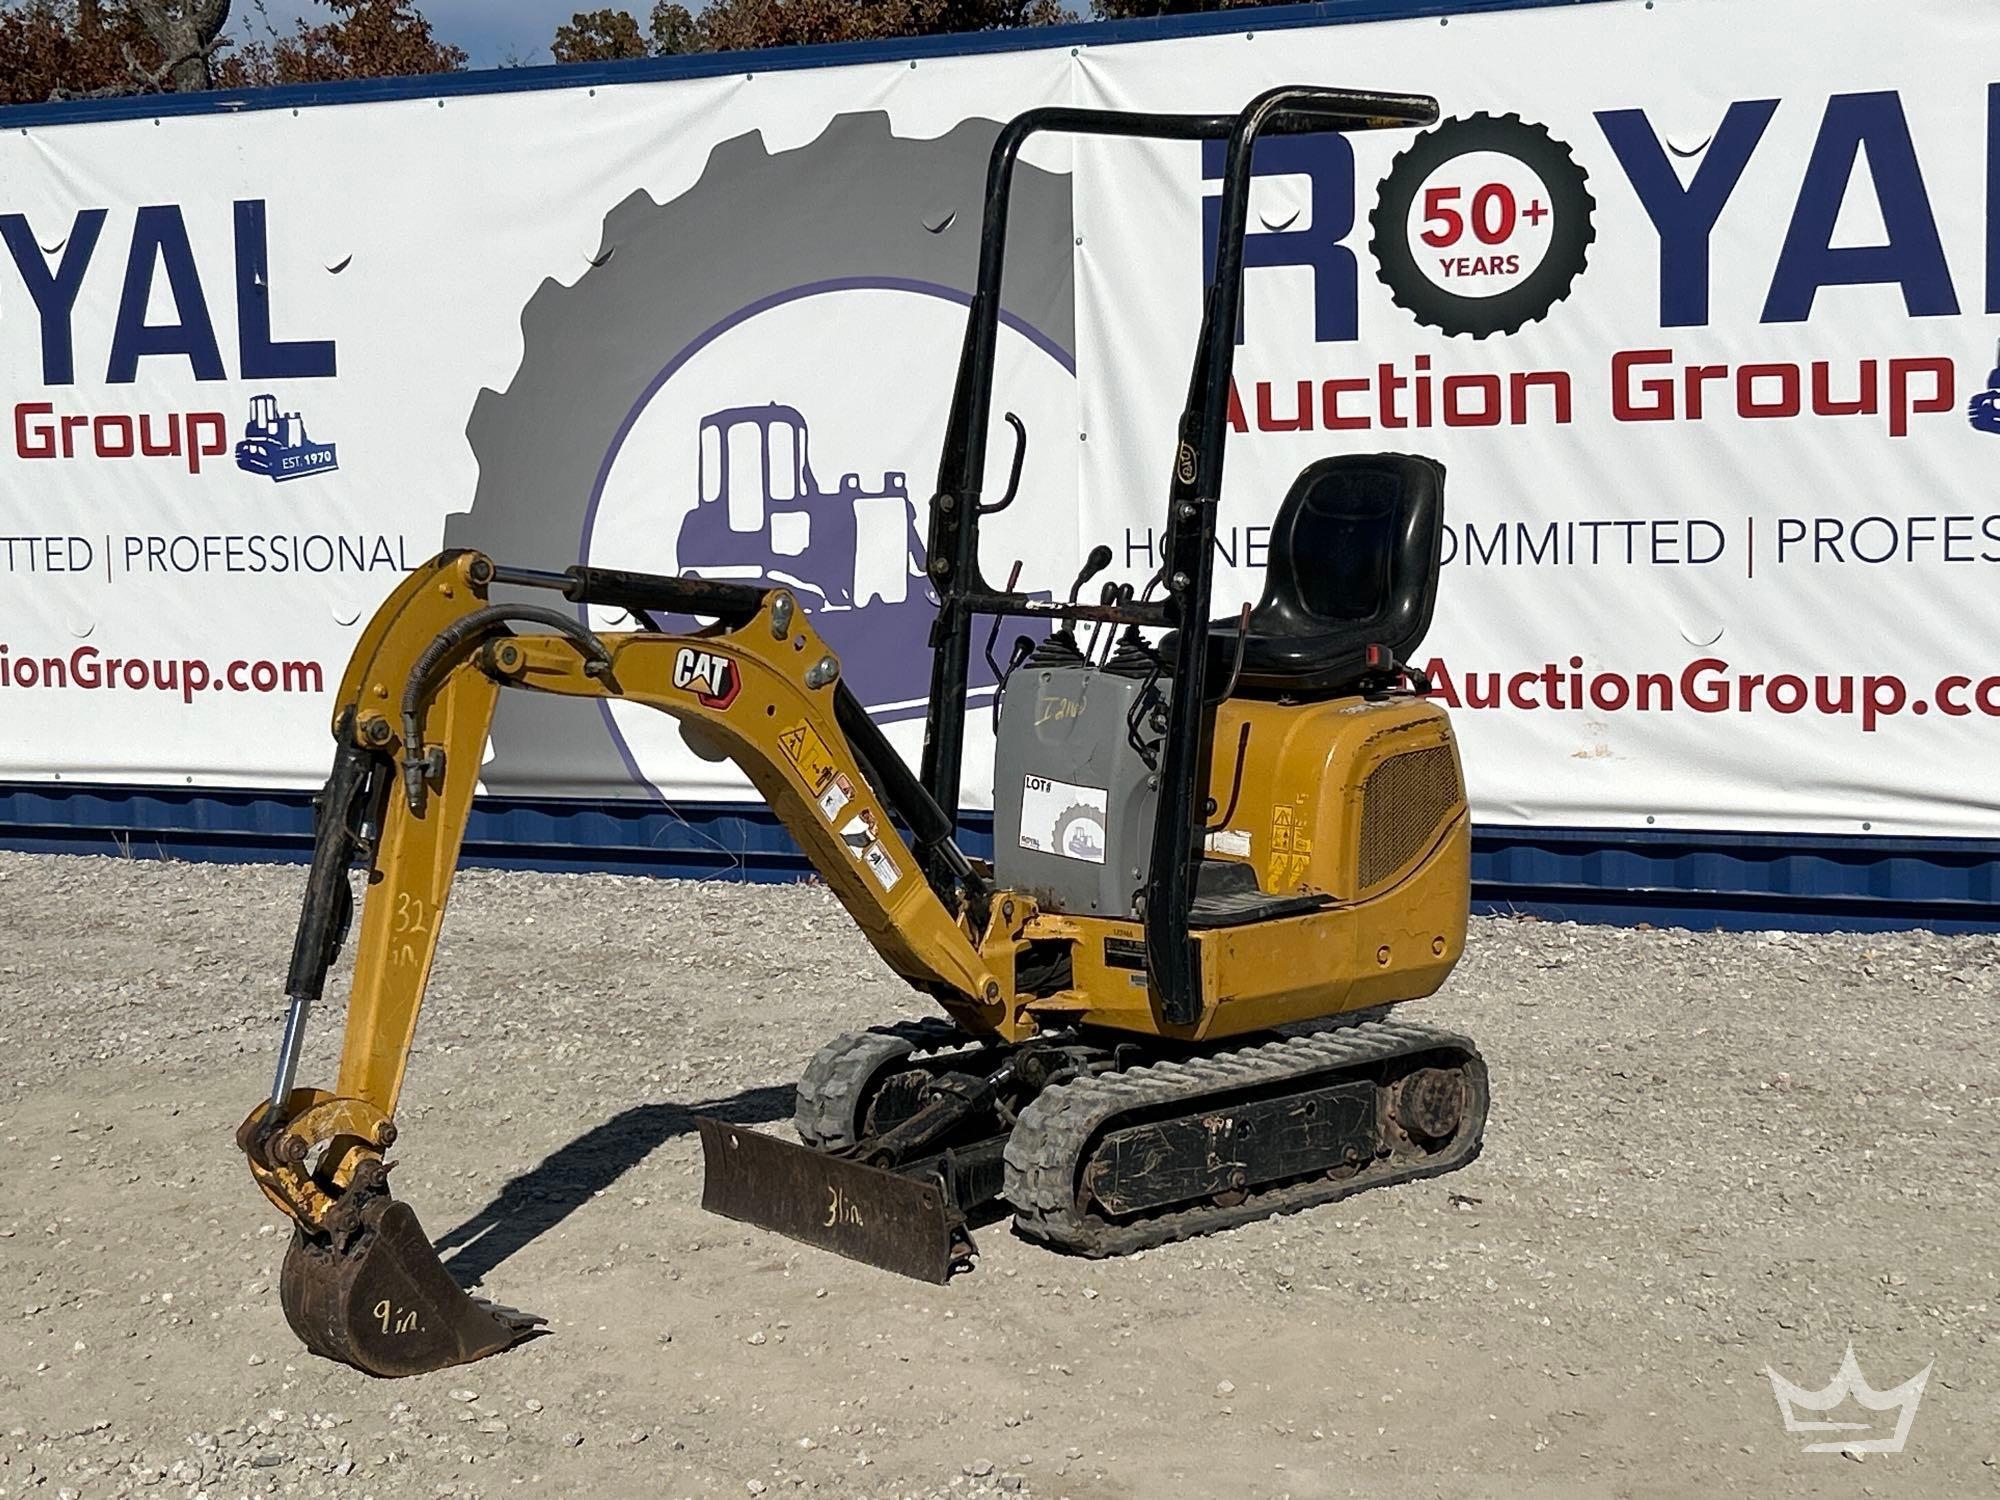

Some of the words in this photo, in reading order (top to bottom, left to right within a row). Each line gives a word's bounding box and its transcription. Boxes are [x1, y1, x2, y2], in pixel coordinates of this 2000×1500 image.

[1419, 182, 1549, 248] 50+
[1440, 255, 1520, 278] YEARS
[1611, 348, 1955, 437] Group
[14, 402, 228, 474] Group
[282, 456, 303, 470] EST.
[304, 450, 332, 466] 1970
[124, 535, 418, 572] PROFESSIONAL
[1, 645, 324, 704] ionGroup.com
[674, 648, 730, 697] CAT
[1396, 656, 2000, 732] AuctionGroup.co
[395, 892, 428, 934] 32
